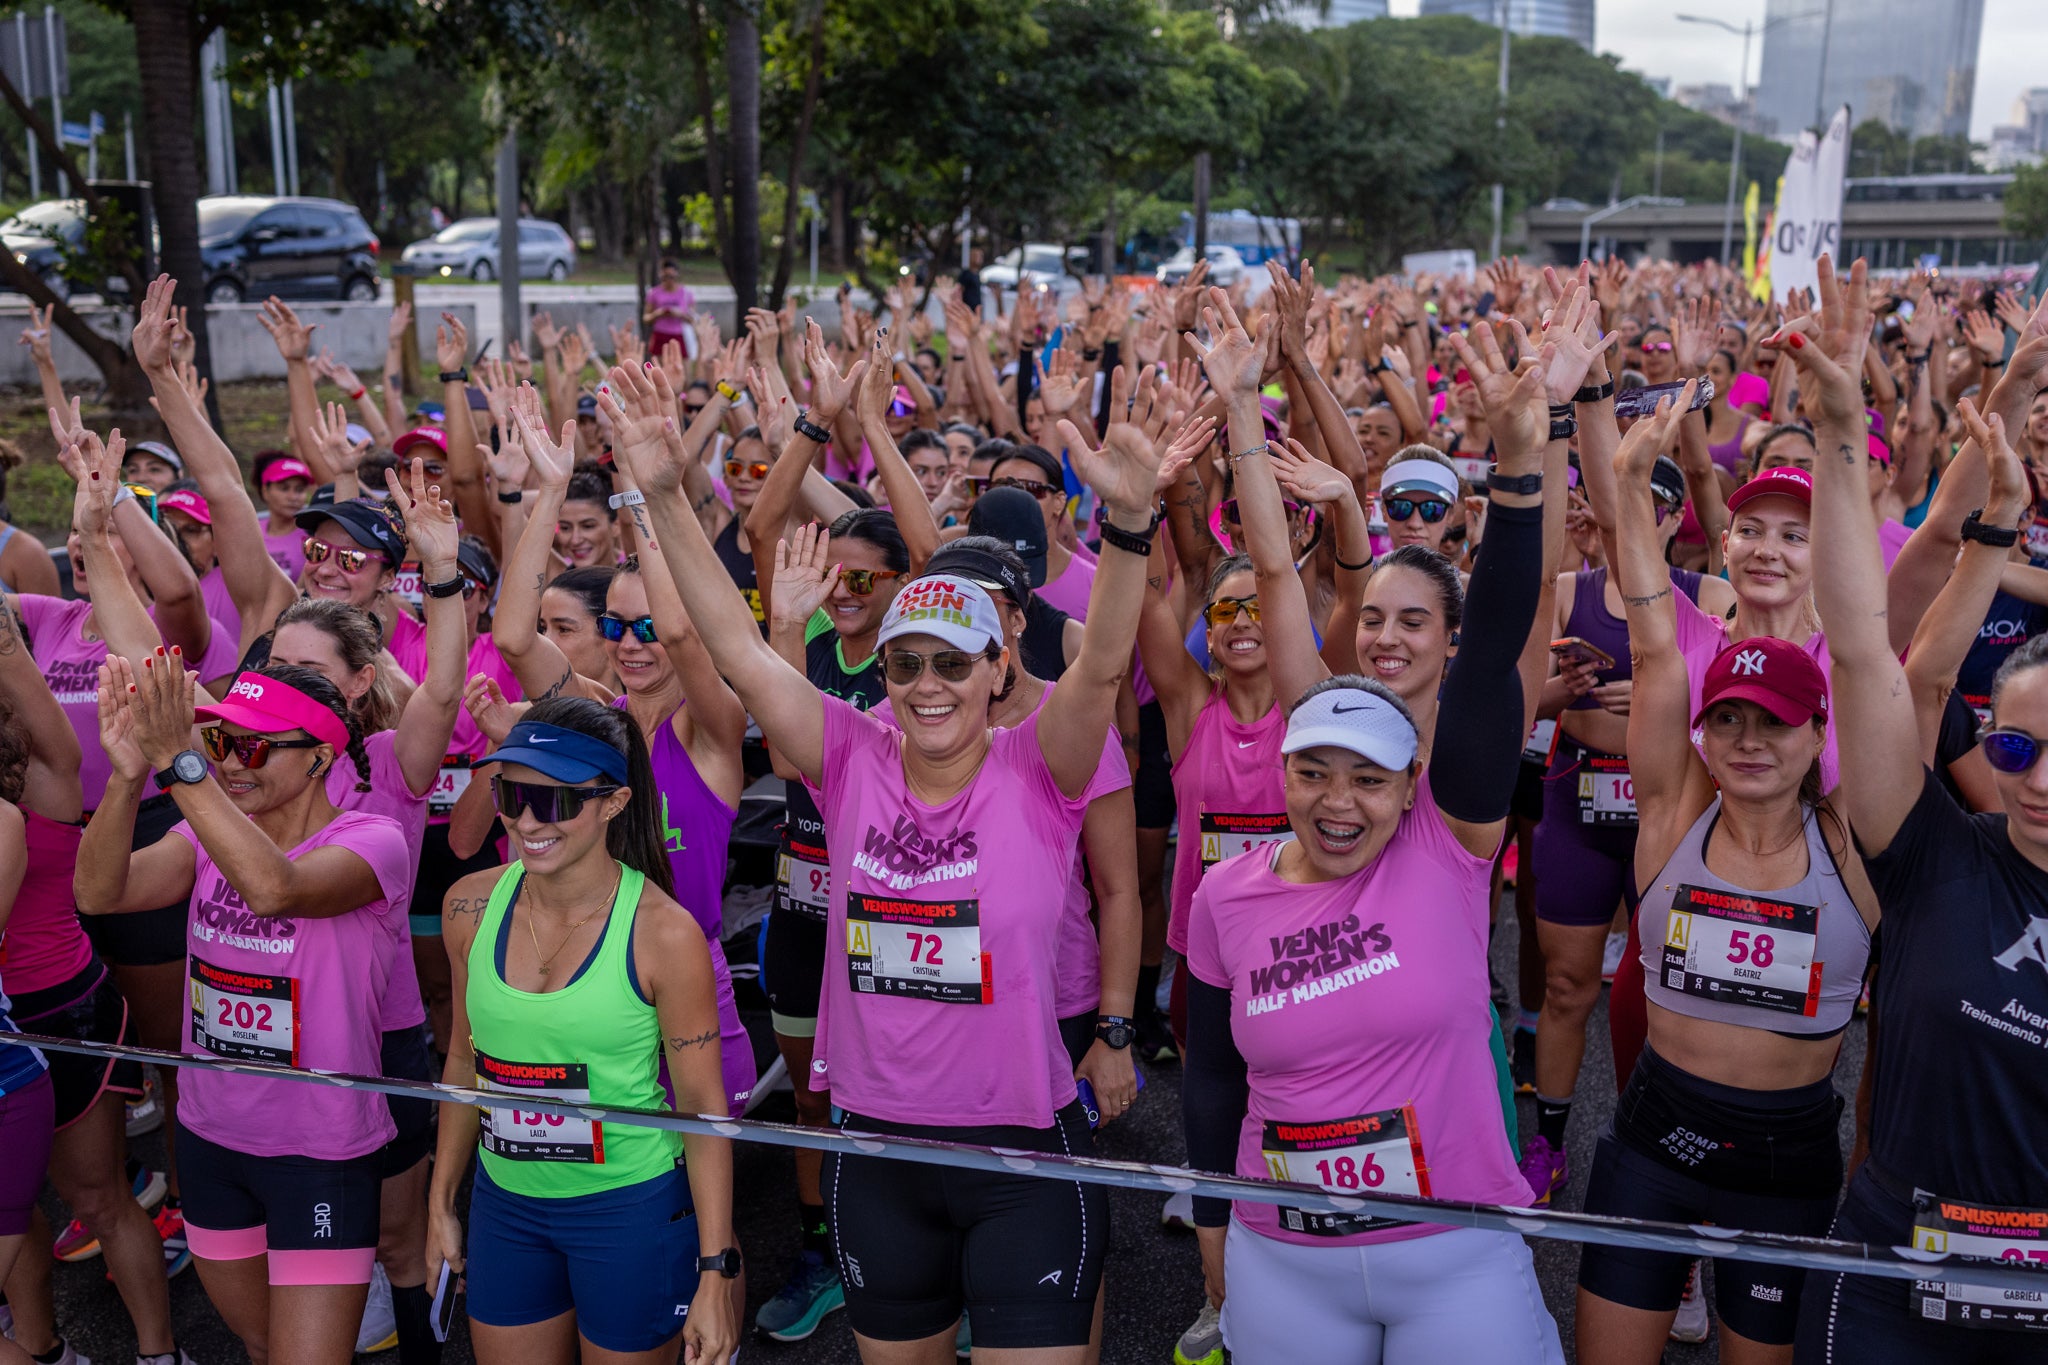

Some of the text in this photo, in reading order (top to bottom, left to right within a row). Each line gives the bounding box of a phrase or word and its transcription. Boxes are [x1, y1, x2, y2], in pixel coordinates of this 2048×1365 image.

[1731, 649, 1767, 675] NY
[1582, 776, 1591, 793] A
[1213, 815, 1288, 827] VENUSWOMEN'S
[1206, 837, 1216, 857] A
[852, 852, 890, 881] HALF
[862, 898, 957, 917] VENUSWOMEN'S
[1690, 889, 1795, 920] VENUSWOMEN'S
[899, 915, 934, 925] MARATHON
[1708, 907, 1769, 924] HALF MARATHON
[853, 926, 866, 951] A
[1671, 917, 1684, 944] A
[906, 932, 944, 965] 72
[1726, 929, 1775, 969] 58
[851, 961, 872, 972] 21.1K
[1250, 923, 1393, 997] WOMEN'S
[1665, 953, 1685, 966] 21.1K
[199, 962, 273, 990] VENUSWOMEN'S
[912, 966, 941, 978] CRISTIANE
[1733, 968, 1762, 980] BEATRIZ
[923, 984, 938, 993] Jeep
[1247, 951, 1400, 1017] HALF MARATHON
[1738, 987, 1756, 997] Jeep
[194, 985, 203, 1010] A
[218, 998, 273, 1032] 202
[1960, 1000, 2042, 1045] Treinamento
[232, 1030, 259, 1041] ROSELENE
[483, 1057, 567, 1080] VENUSWOMEN'S
[509, 1077, 545, 1087] MARATHON
[529, 1129, 547, 1138] LAIZA
[1276, 1117, 1382, 1141] VENUSWOMEN'S
[1676, 1126, 1719, 1151] COMP
[534, 1146, 550, 1154] Jeep
[1296, 1136, 1358, 1150] HALF MARATHON
[1659, 1138, 1700, 1167] PORT
[1667, 1132, 1706, 1160] RESS
[1271, 1157, 1283, 1182] A
[1316, 1152, 1385, 1190] 186
[313, 1202, 331, 1238] BIRD
[1353, 1214, 1372, 1222] Jeep
[1968, 1224, 2040, 1238] HALF MARATHON
[1752, 1283, 1783, 1296] vivás
[1916, 1279, 1945, 1293] 21.1K
[1752, 1290, 1782, 1302] move
[2003, 1290, 2042, 1302] GABRIELA
[2014, 1312, 2036, 1322] Jeep
